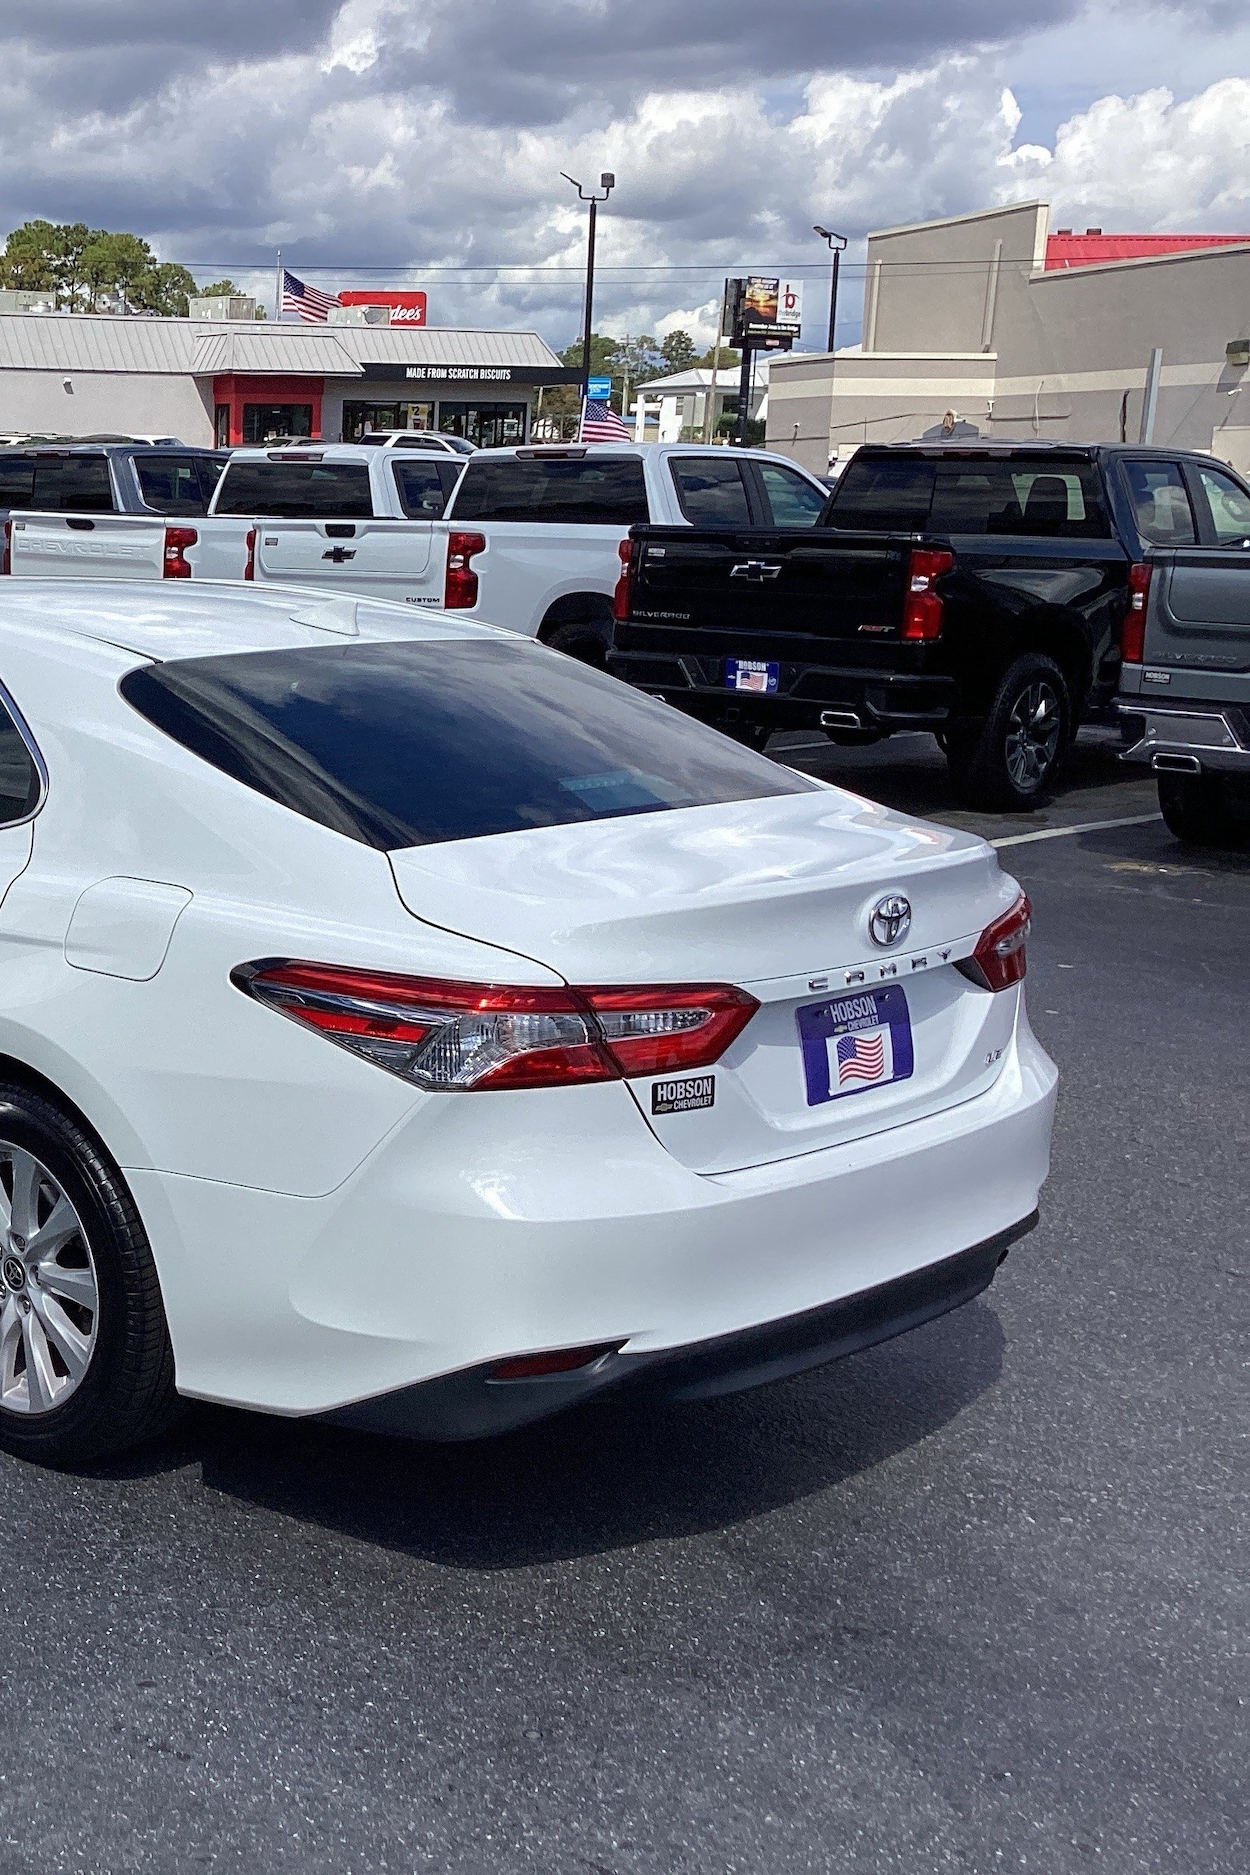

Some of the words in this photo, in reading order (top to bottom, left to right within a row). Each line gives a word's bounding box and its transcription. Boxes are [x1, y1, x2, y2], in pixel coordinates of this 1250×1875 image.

[406, 367, 426, 379] MADE
[427, 367, 447, 379] FROM
[448, 368, 479, 379] SCRATCH
[480, 369, 511, 380] BISCUITS
[17, 539, 151, 558] CHEVROLET
[632, 610, 691, 620] SILVERADO
[738, 660, 767, 671] HOBSON
[808, 948, 952, 992] CAMRY
[829, 995, 878, 1024] HOBSON
[848, 1014, 880, 1031] CHEVROLET
[657, 1078, 712, 1101] HOBSON
[673, 1096, 712, 1110] CHEVROLET
